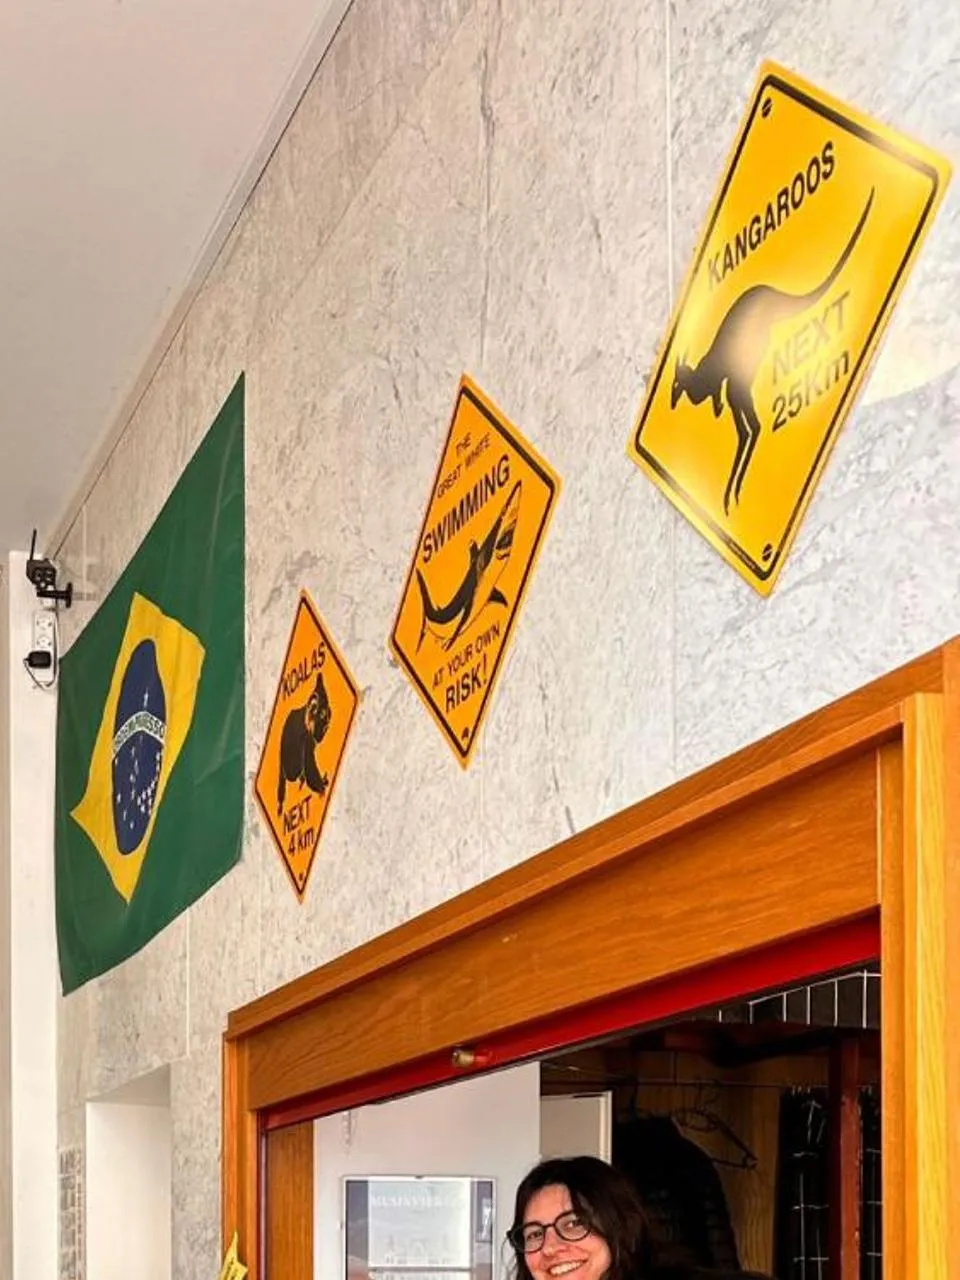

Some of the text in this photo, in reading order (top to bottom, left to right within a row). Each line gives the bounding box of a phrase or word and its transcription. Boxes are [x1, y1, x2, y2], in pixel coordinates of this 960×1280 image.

[707, 140, 836, 291] KANGAROOS
[771, 290, 851, 385] NEXT
[455, 431, 472, 458] THE
[422, 453, 510, 563] SWIMMING
[437, 463, 461, 499] GREAT
[281, 640, 326, 702] KOALAS
[432, 619, 500, 691] AT YOUR OWN
[445, 652, 487, 714] RISK!
[283, 792, 312, 837] NEXT
